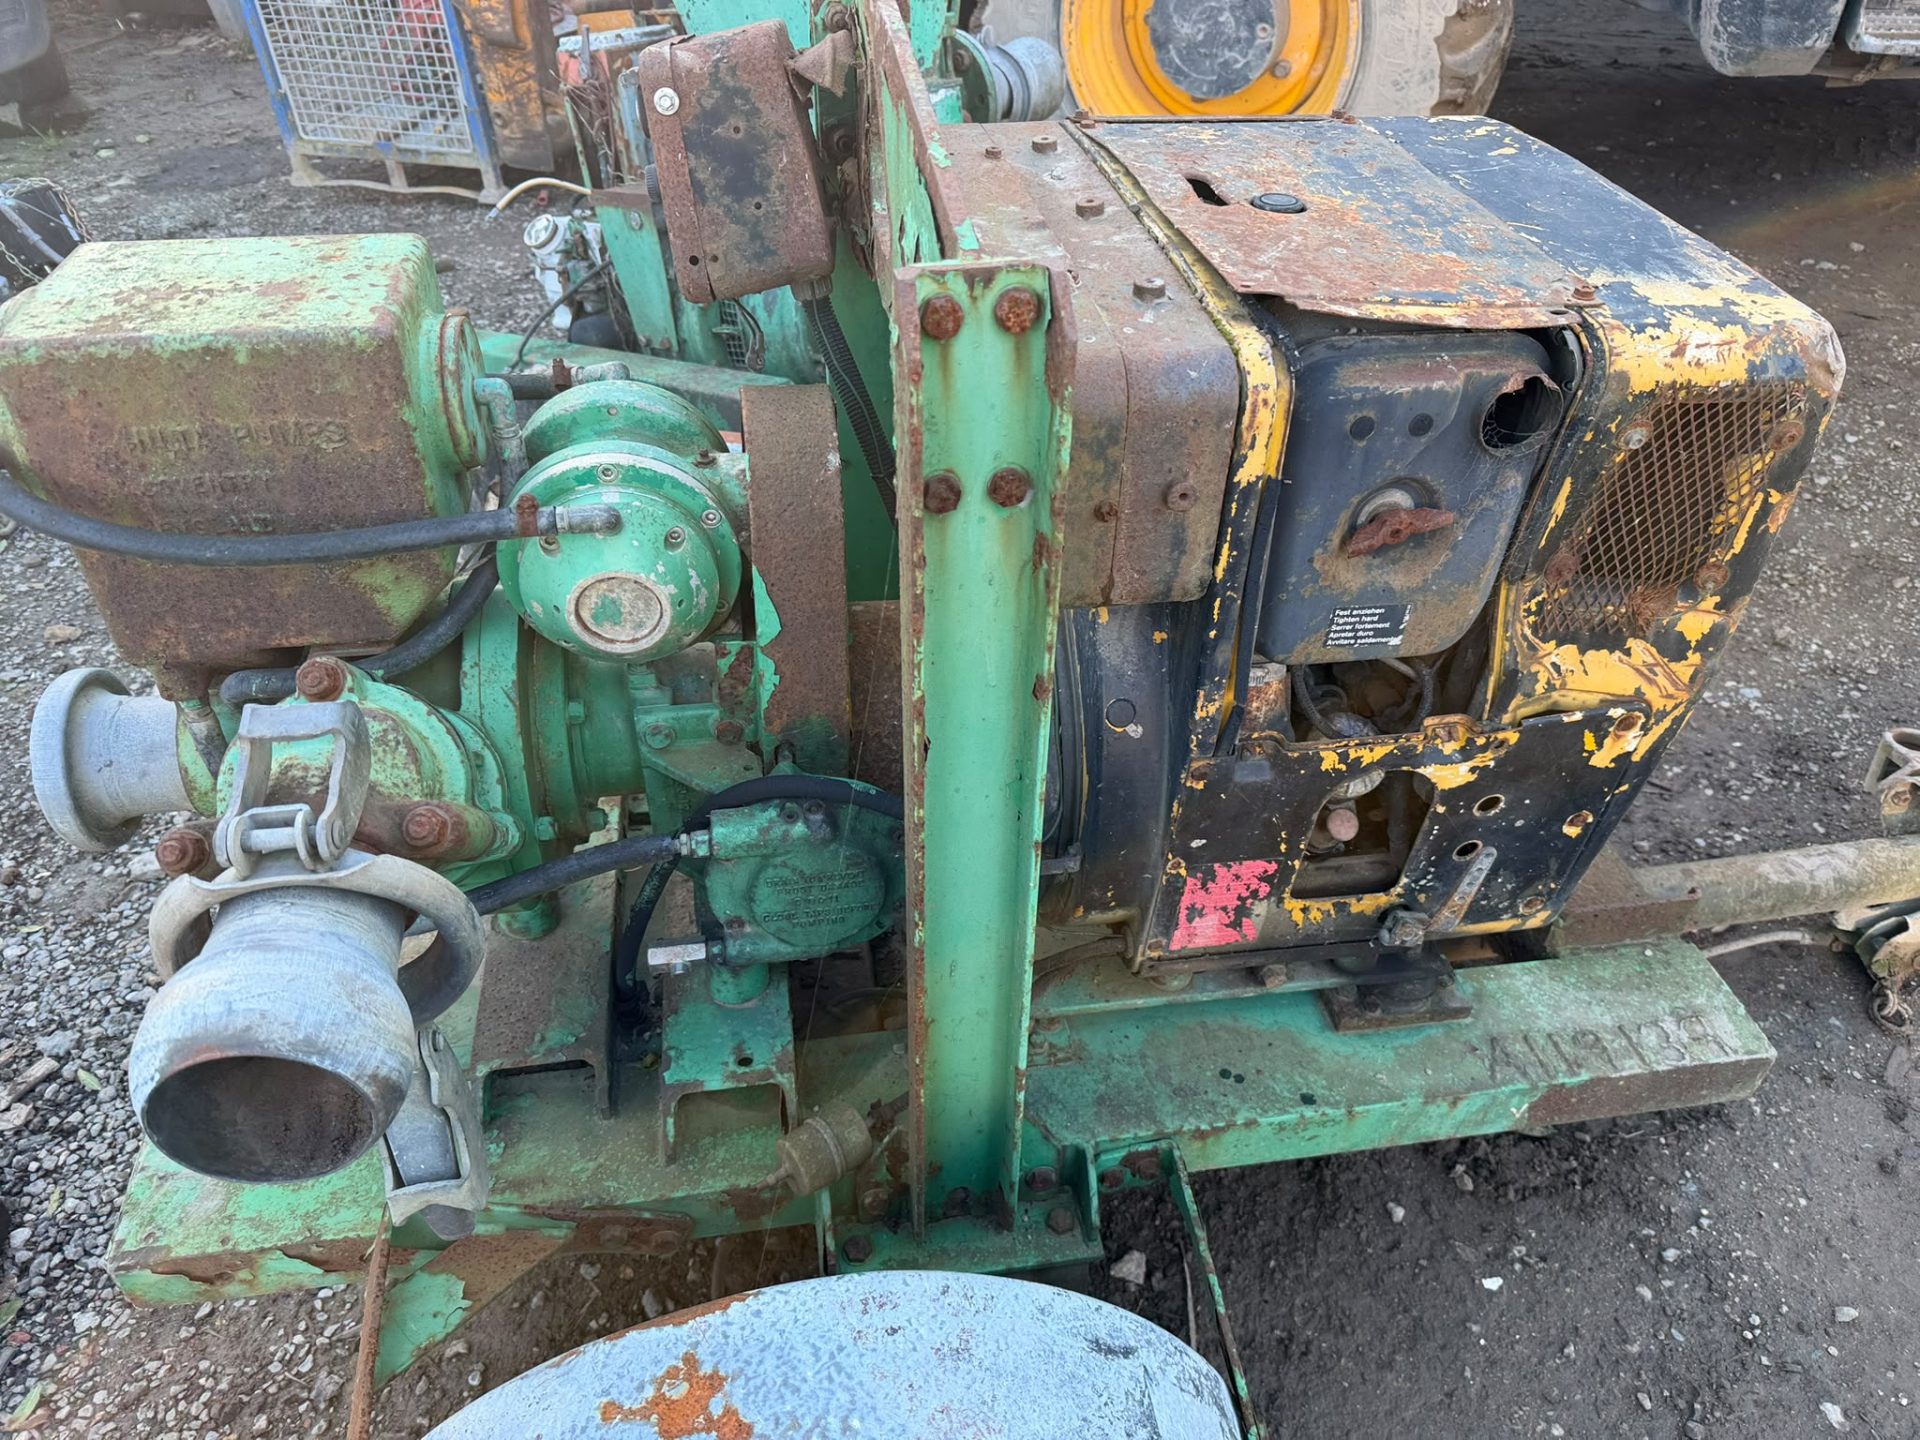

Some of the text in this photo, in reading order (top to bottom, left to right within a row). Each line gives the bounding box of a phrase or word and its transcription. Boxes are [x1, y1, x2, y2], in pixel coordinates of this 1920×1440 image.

[230, 419, 350, 453] PUMPS
[1352, 608, 1385, 616] anziehen
[1333, 616, 1360, 624] Tighten
[1354, 622, 1390, 630] fortement
[1328, 631, 1355, 639] Apretar
[1326, 638, 1355, 646] Avvitare
[791, 915, 846, 929] PUMPING
